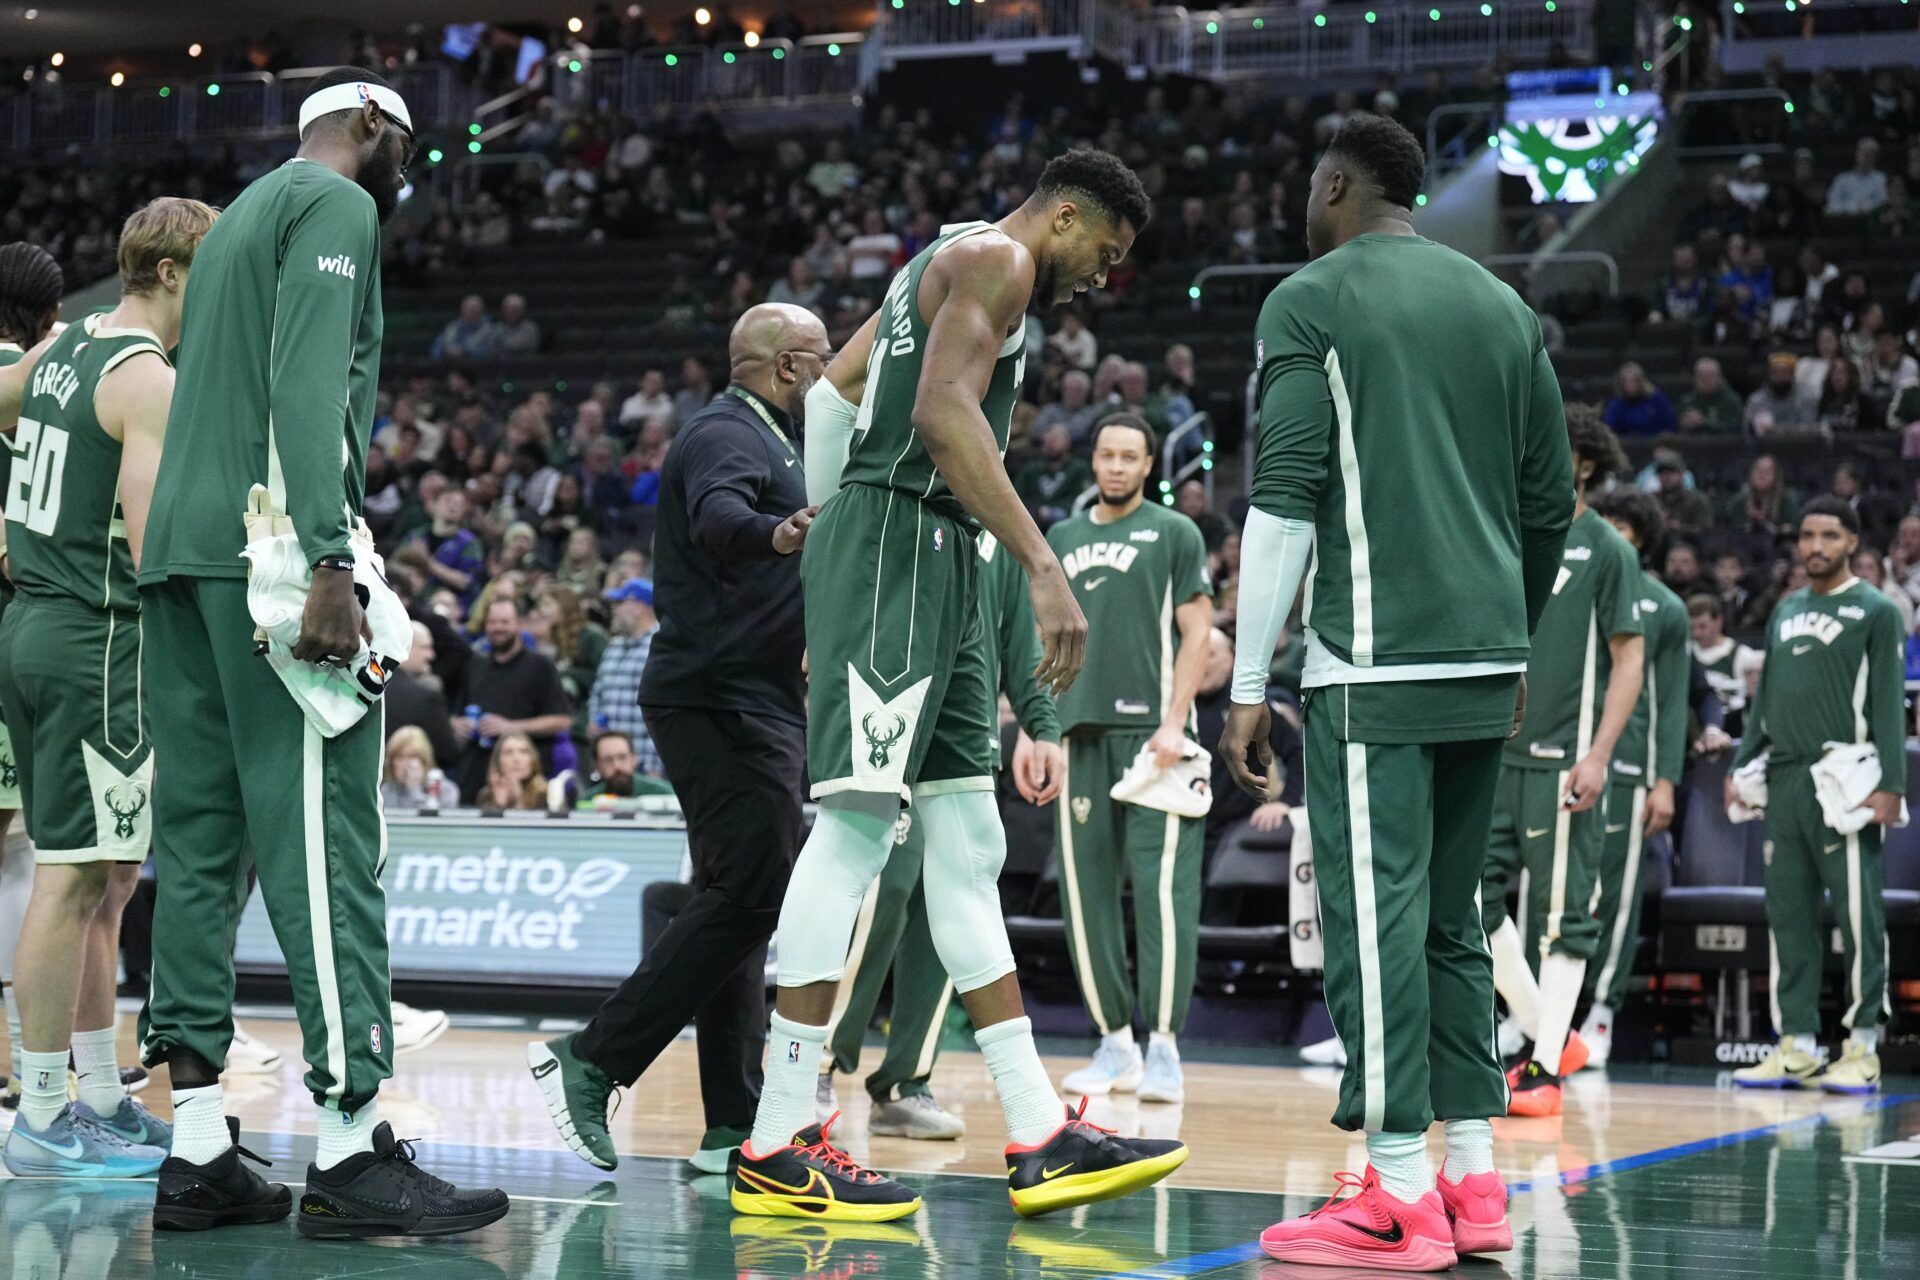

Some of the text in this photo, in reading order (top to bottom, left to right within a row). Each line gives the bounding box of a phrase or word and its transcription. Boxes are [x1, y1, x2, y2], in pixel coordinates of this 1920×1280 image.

[32, 361, 80, 410] GREEN
[4, 416, 69, 537] 20
[1062, 542, 1140, 580] BUCKS
[1780, 611, 1844, 646] BUCKS
[394, 847, 567, 898] metro
[387, 898, 584, 951] market
